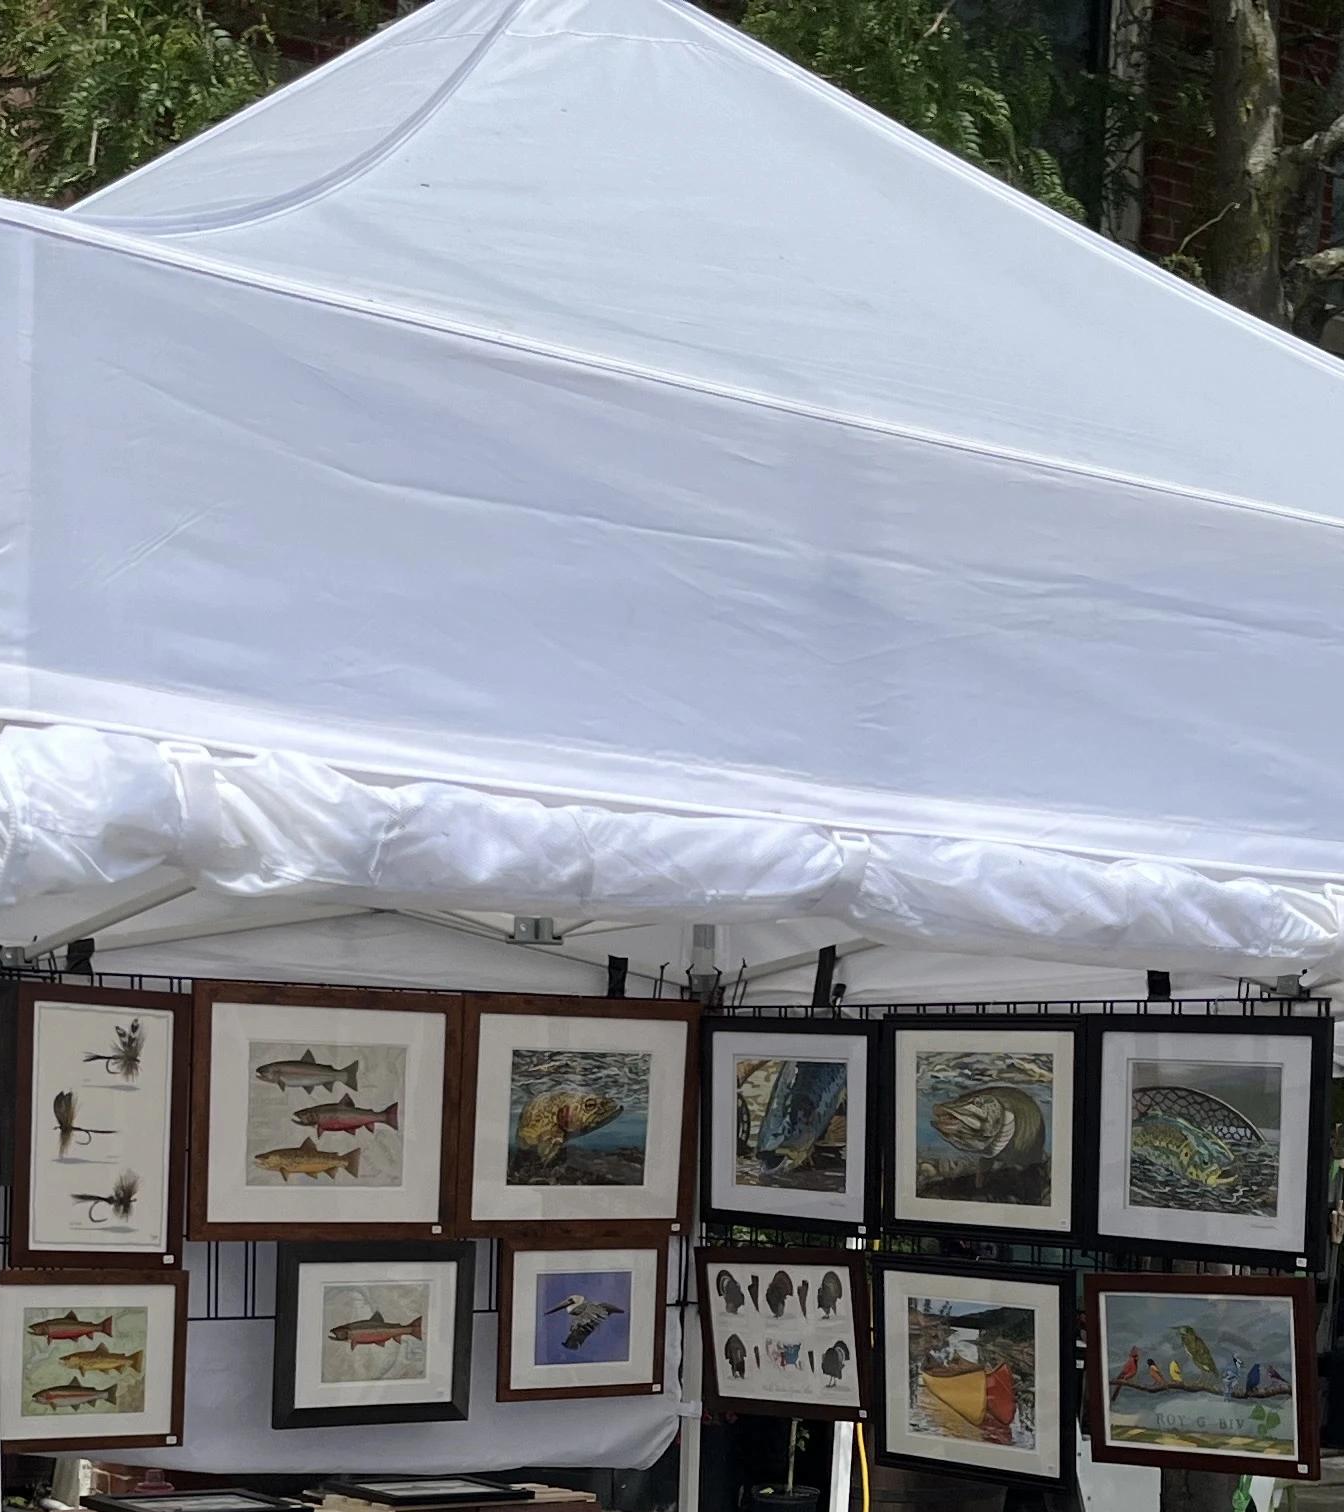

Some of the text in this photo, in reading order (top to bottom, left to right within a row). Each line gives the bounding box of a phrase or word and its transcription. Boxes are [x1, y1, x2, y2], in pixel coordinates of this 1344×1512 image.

[1156, 1412, 1245, 1430] ROY G BIV
